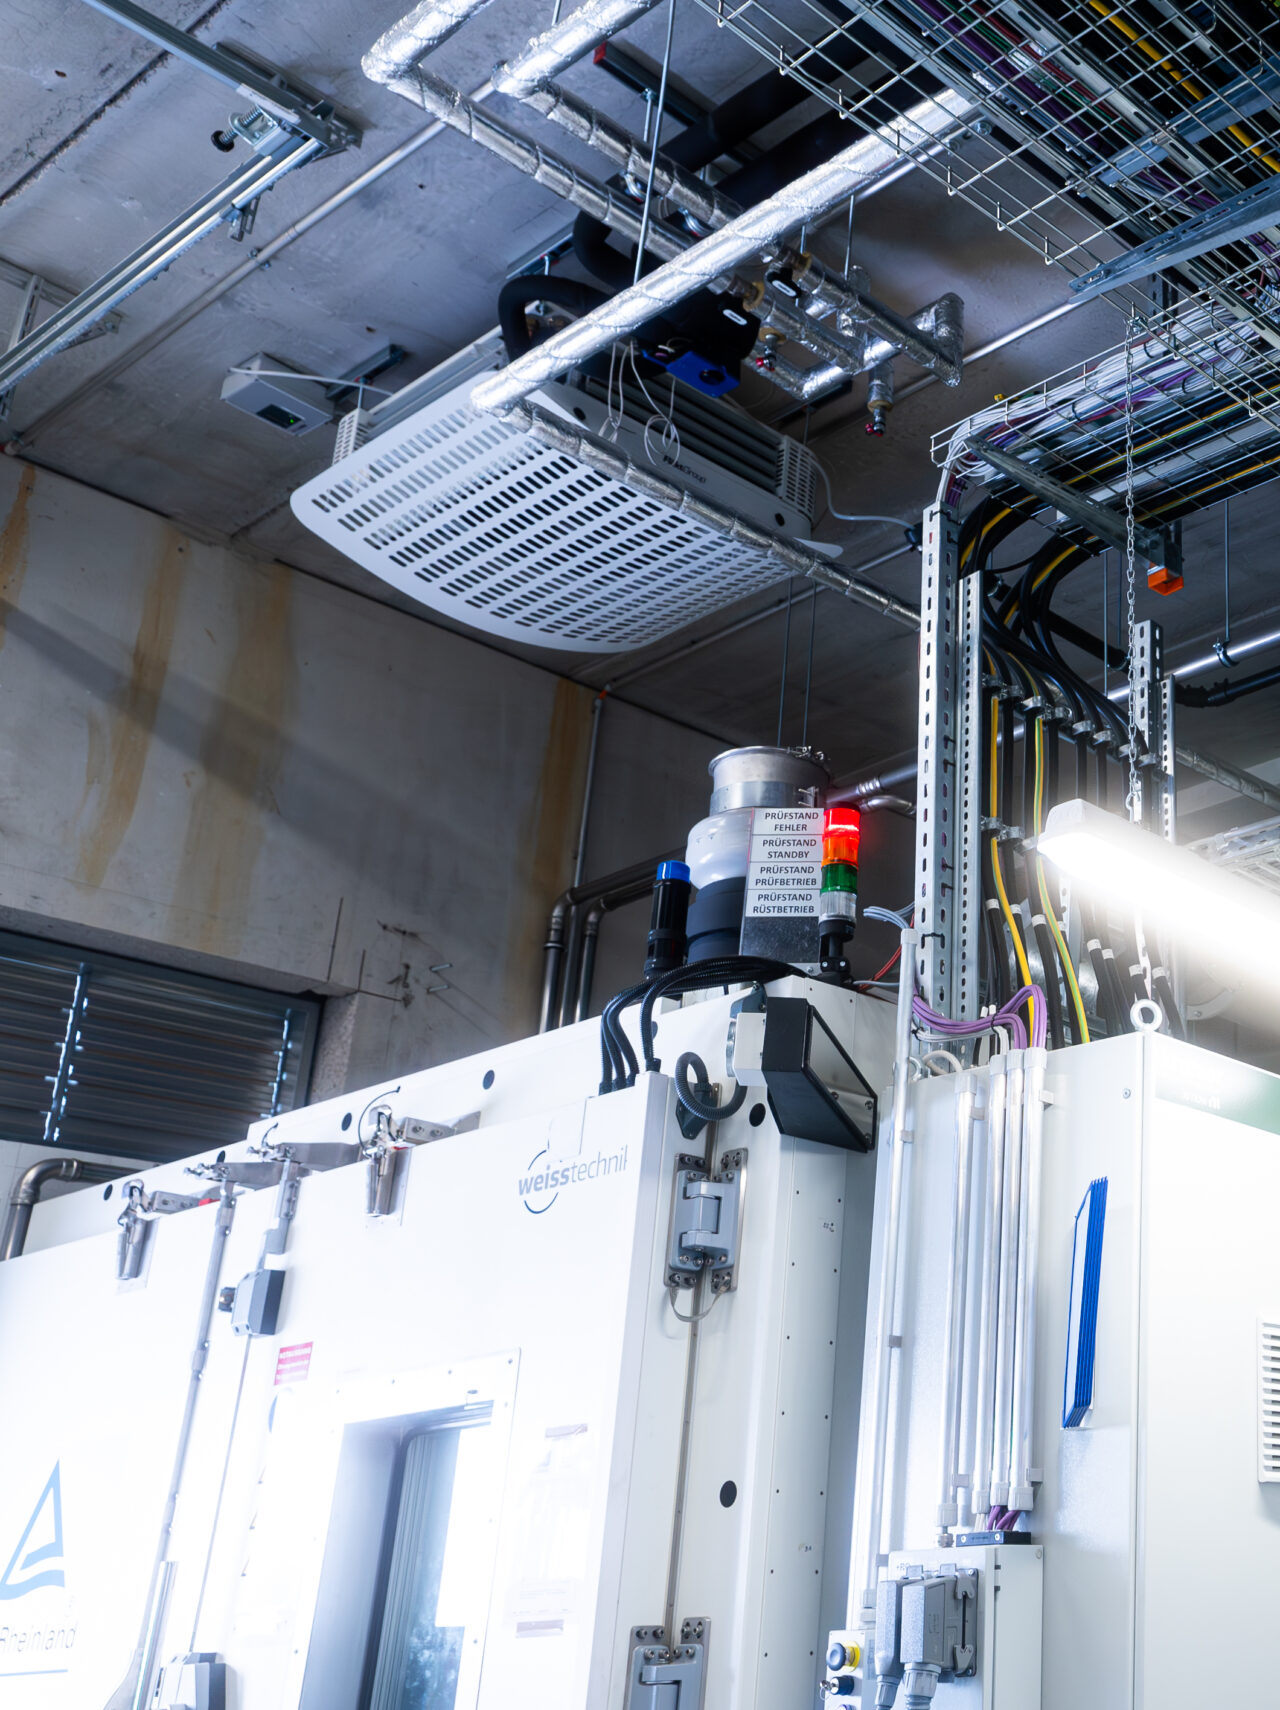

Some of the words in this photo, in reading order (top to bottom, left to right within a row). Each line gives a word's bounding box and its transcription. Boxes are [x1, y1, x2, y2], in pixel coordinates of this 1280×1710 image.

[764, 810, 818, 820] PRÜFSTAND
[774, 823, 808, 832] FEHLER
[762, 838, 817, 847] PRÜFSTAND
[767, 850, 810, 859] STANDBY
[760, 864, 814, 874] PRÜFSTAND
[755, 876, 817, 886] PRÜFBETRIEB
[757, 892, 813, 901] PRÜFSTAND
[753, 904, 815, 914] RÜSTBETRIEB
